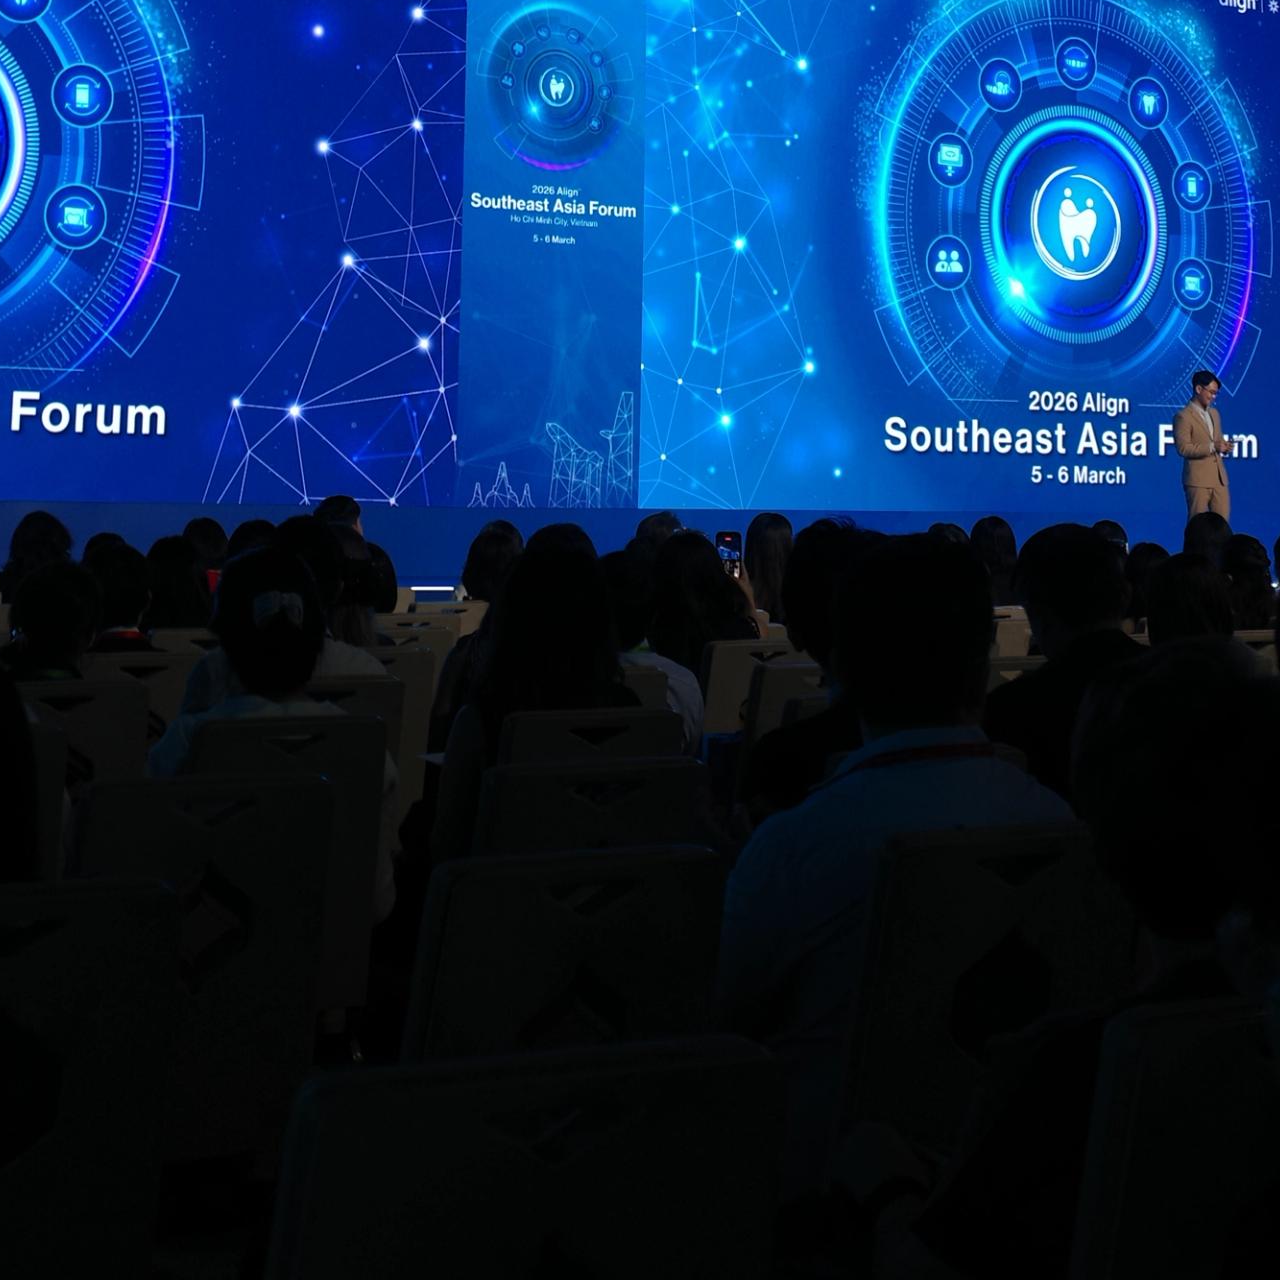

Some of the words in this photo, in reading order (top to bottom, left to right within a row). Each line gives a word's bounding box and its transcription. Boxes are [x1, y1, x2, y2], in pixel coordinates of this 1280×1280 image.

[532, 185, 555, 195] 2026
[557, 186, 578, 198] Align
[471, 192, 549, 212] Southeast
[553, 198, 585, 214] Asia
[589, 201, 637, 218] Forum
[533, 235, 538, 243] 5
[552, 235, 575, 244] March
[11, 391, 166, 434] Forum
[1028, 391, 1078, 412] 2026
[1083, 393, 1129, 416] Align
[884, 416, 1066, 455] Southeast
[1077, 422, 1147, 457] Asia
[1031, 466, 1042, 482] 5
[1058, 466, 1069, 483] 6
[1074, 466, 1125, 484] March
